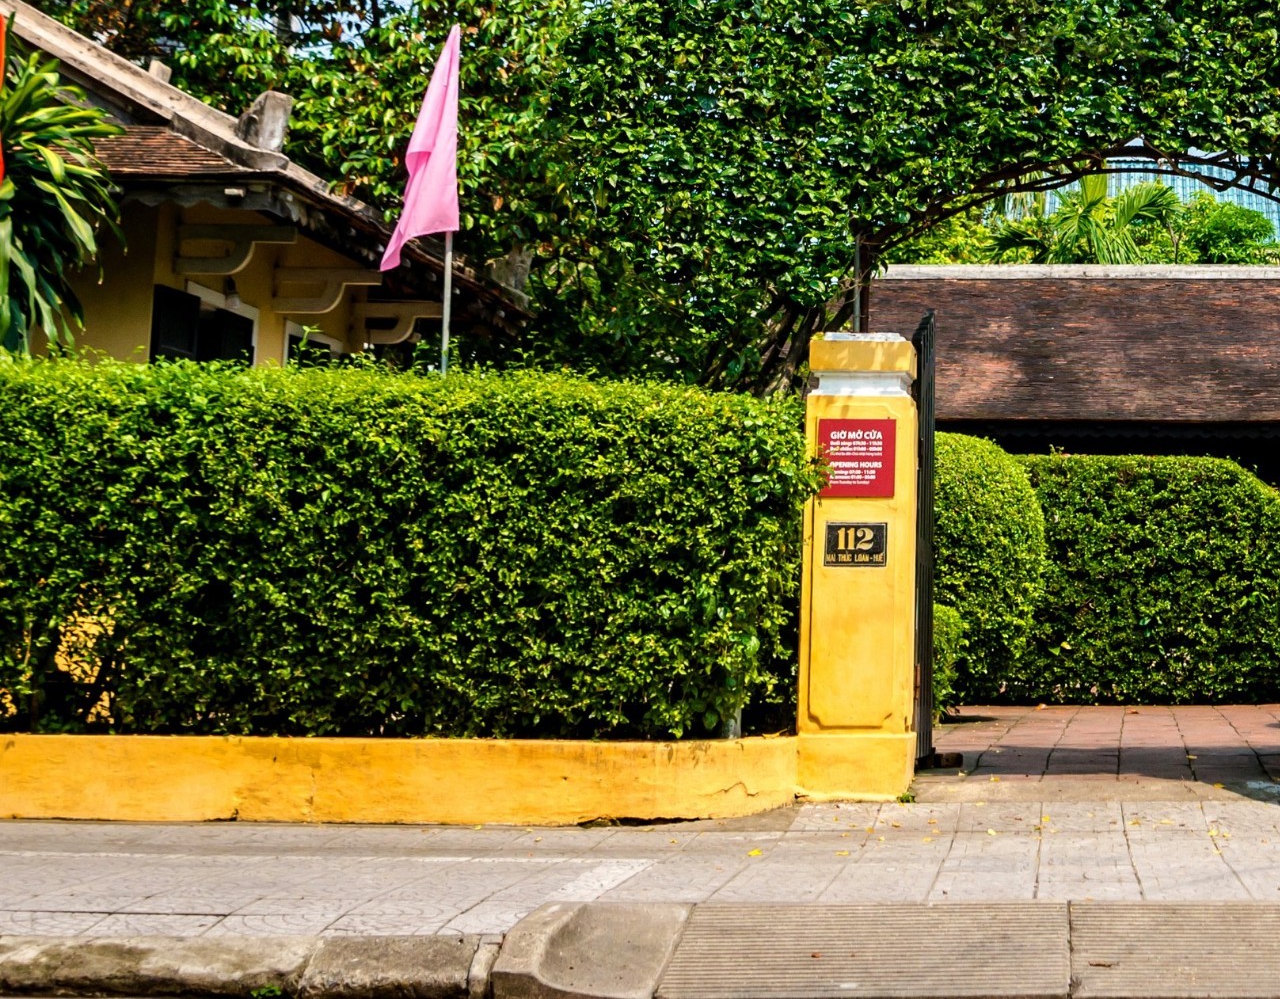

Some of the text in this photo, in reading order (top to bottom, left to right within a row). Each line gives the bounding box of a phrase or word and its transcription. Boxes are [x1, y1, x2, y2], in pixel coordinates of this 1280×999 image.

[830, 429, 882, 439] GIỜ MỞ CỬA
[838, 527, 874, 550] 112
